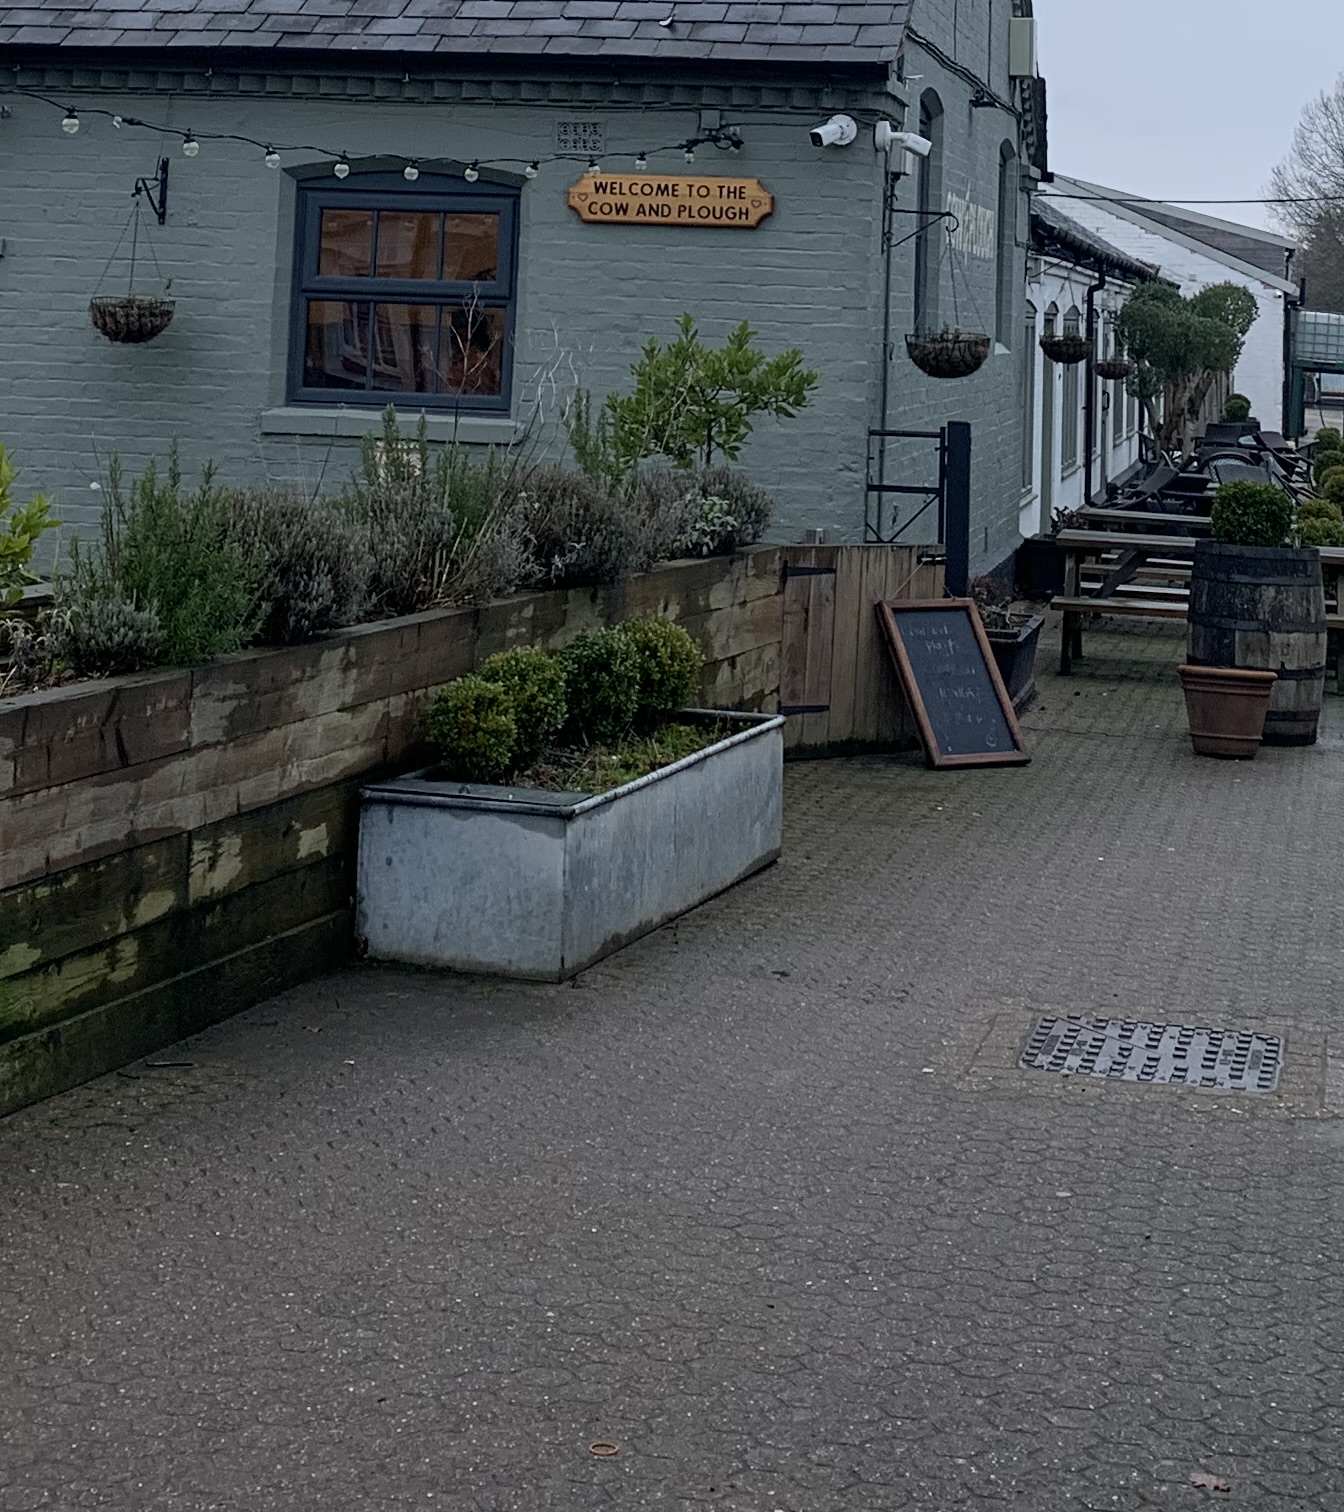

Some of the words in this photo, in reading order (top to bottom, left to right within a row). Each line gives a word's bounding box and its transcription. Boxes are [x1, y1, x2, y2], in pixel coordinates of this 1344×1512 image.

[593, 180, 680, 198] WELCOME
[687, 184, 710, 199] TO
[718, 185, 747, 200] THE
[588, 201, 629, 216] COW
[636, 203, 672, 219] AND
[677, 205, 749, 221] PLOUGH
